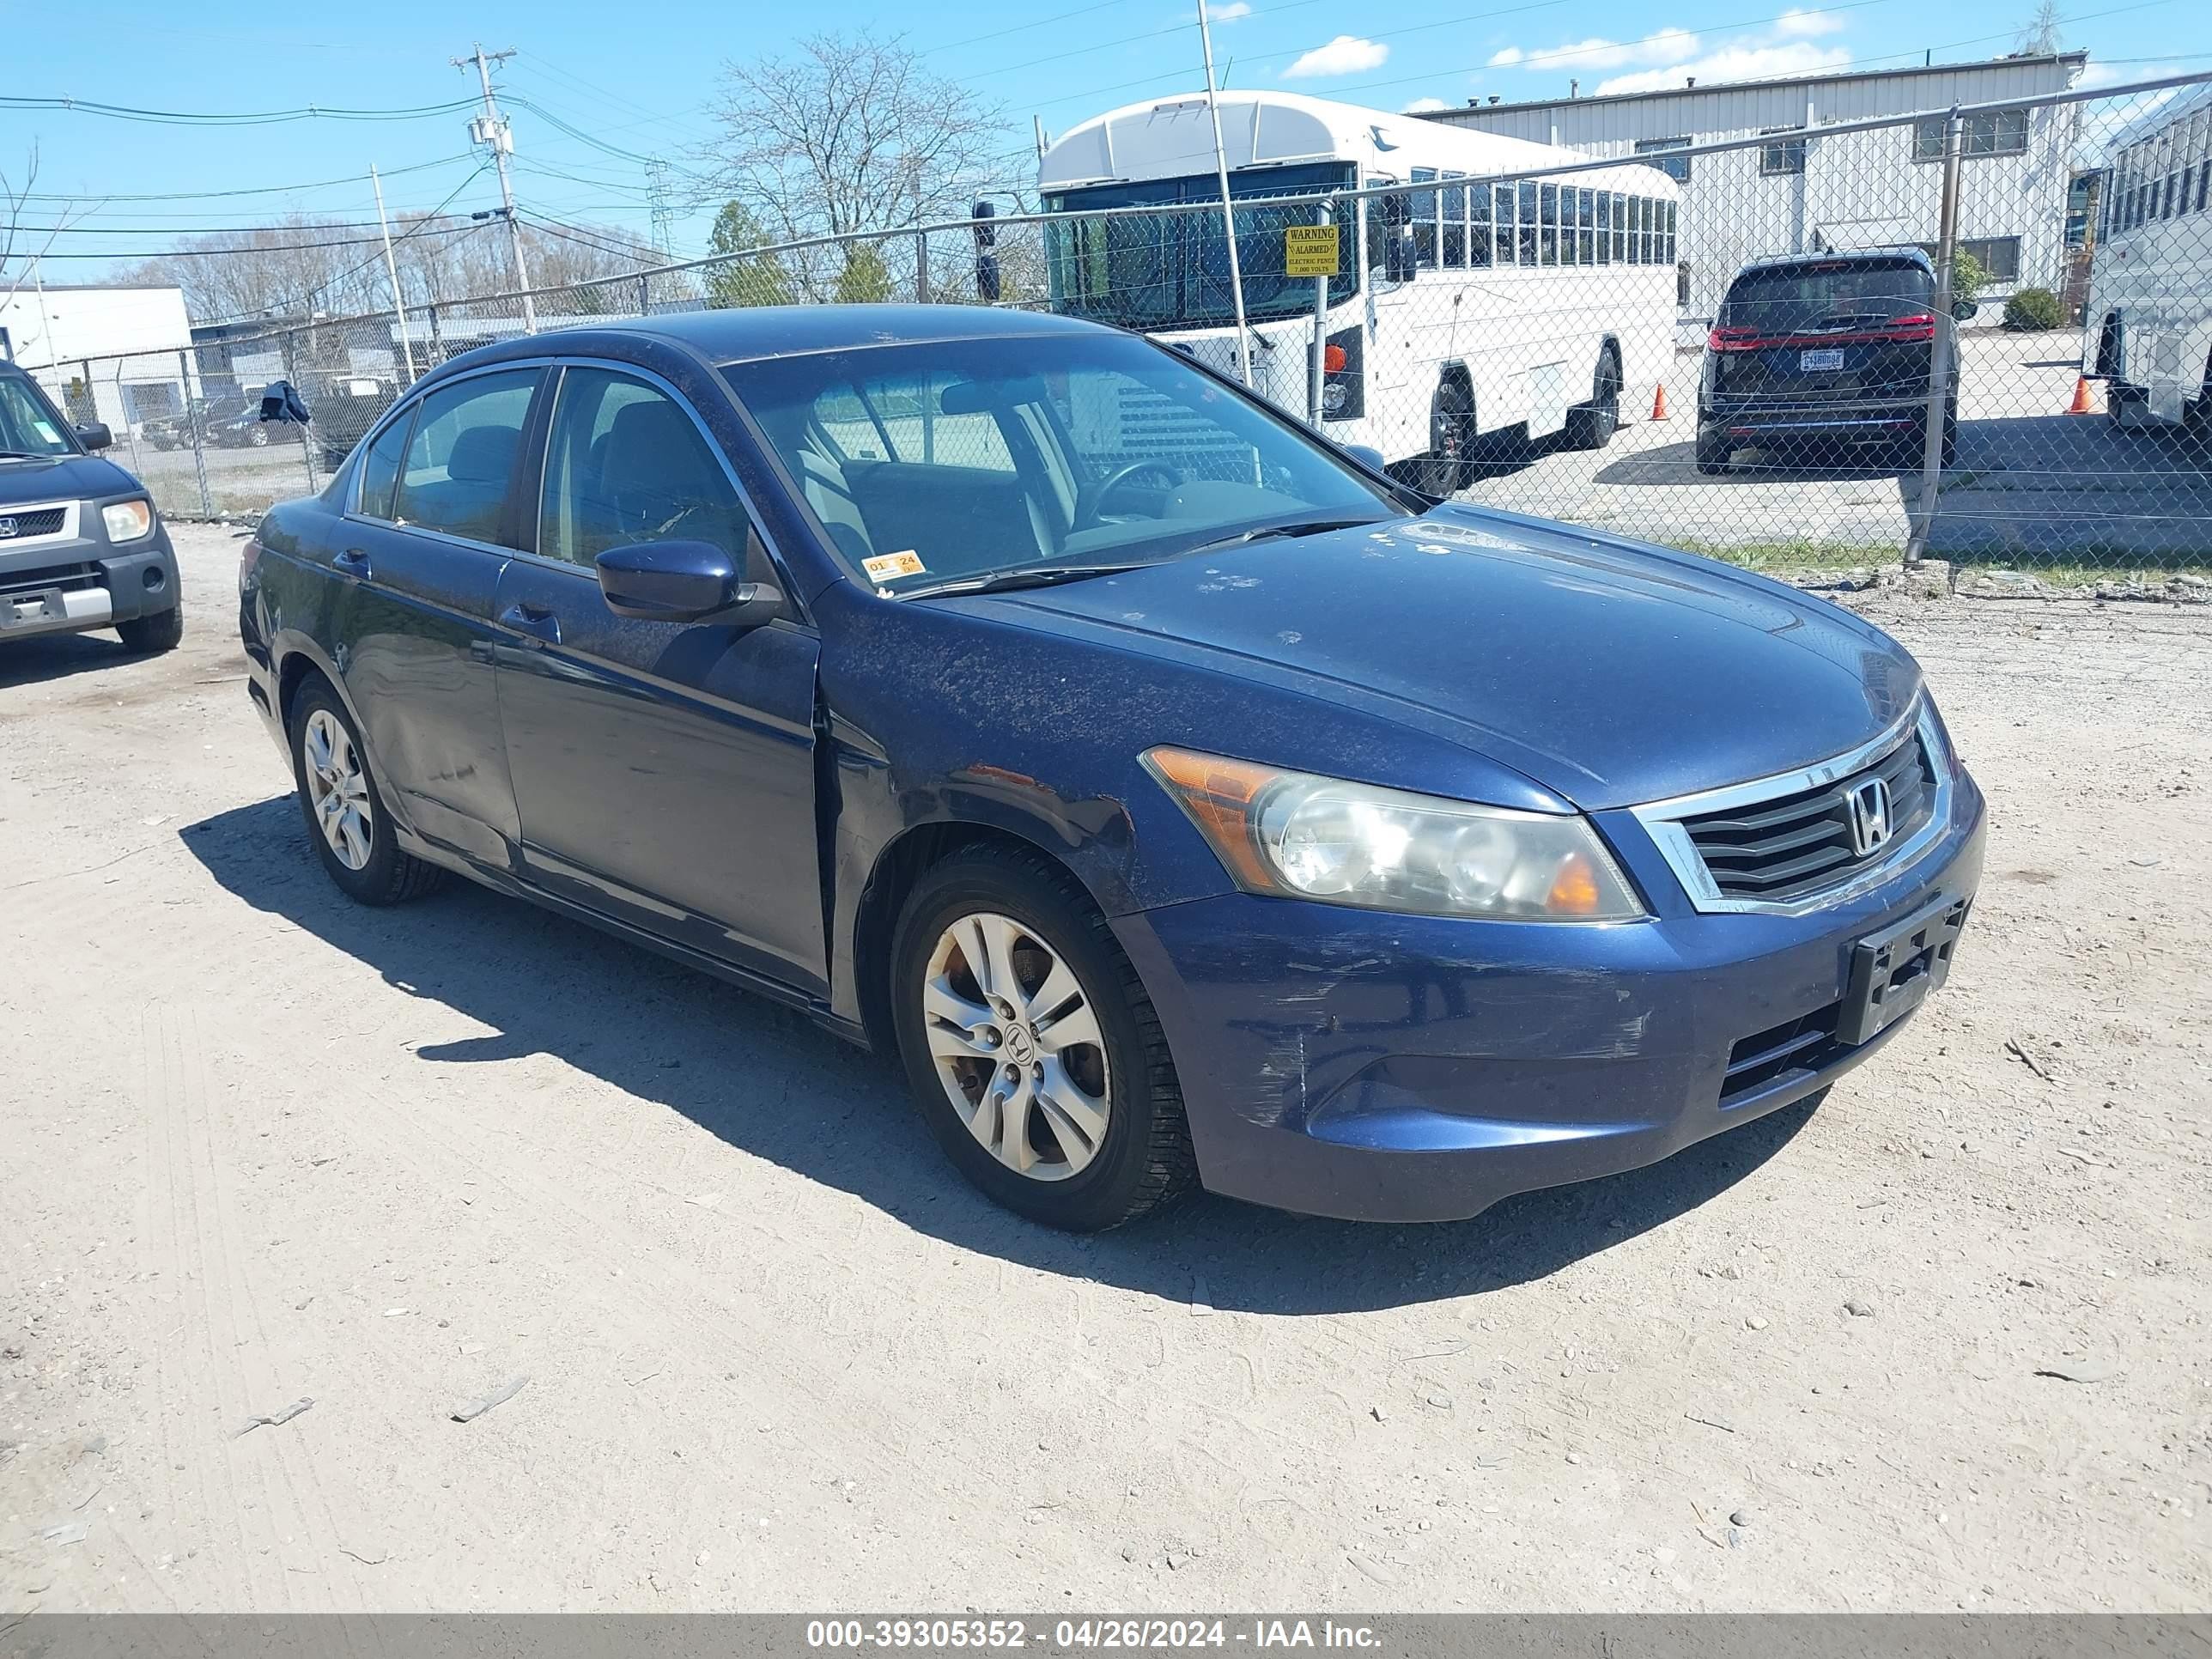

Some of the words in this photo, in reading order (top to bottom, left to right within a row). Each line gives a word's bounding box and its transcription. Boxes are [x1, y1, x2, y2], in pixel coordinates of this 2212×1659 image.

[1291, 228, 1334, 240] WARNING
[1296, 246, 1329, 254] ALARMED
[870, 562, 886, 571] 01
[900, 556, 915, 565] 24
